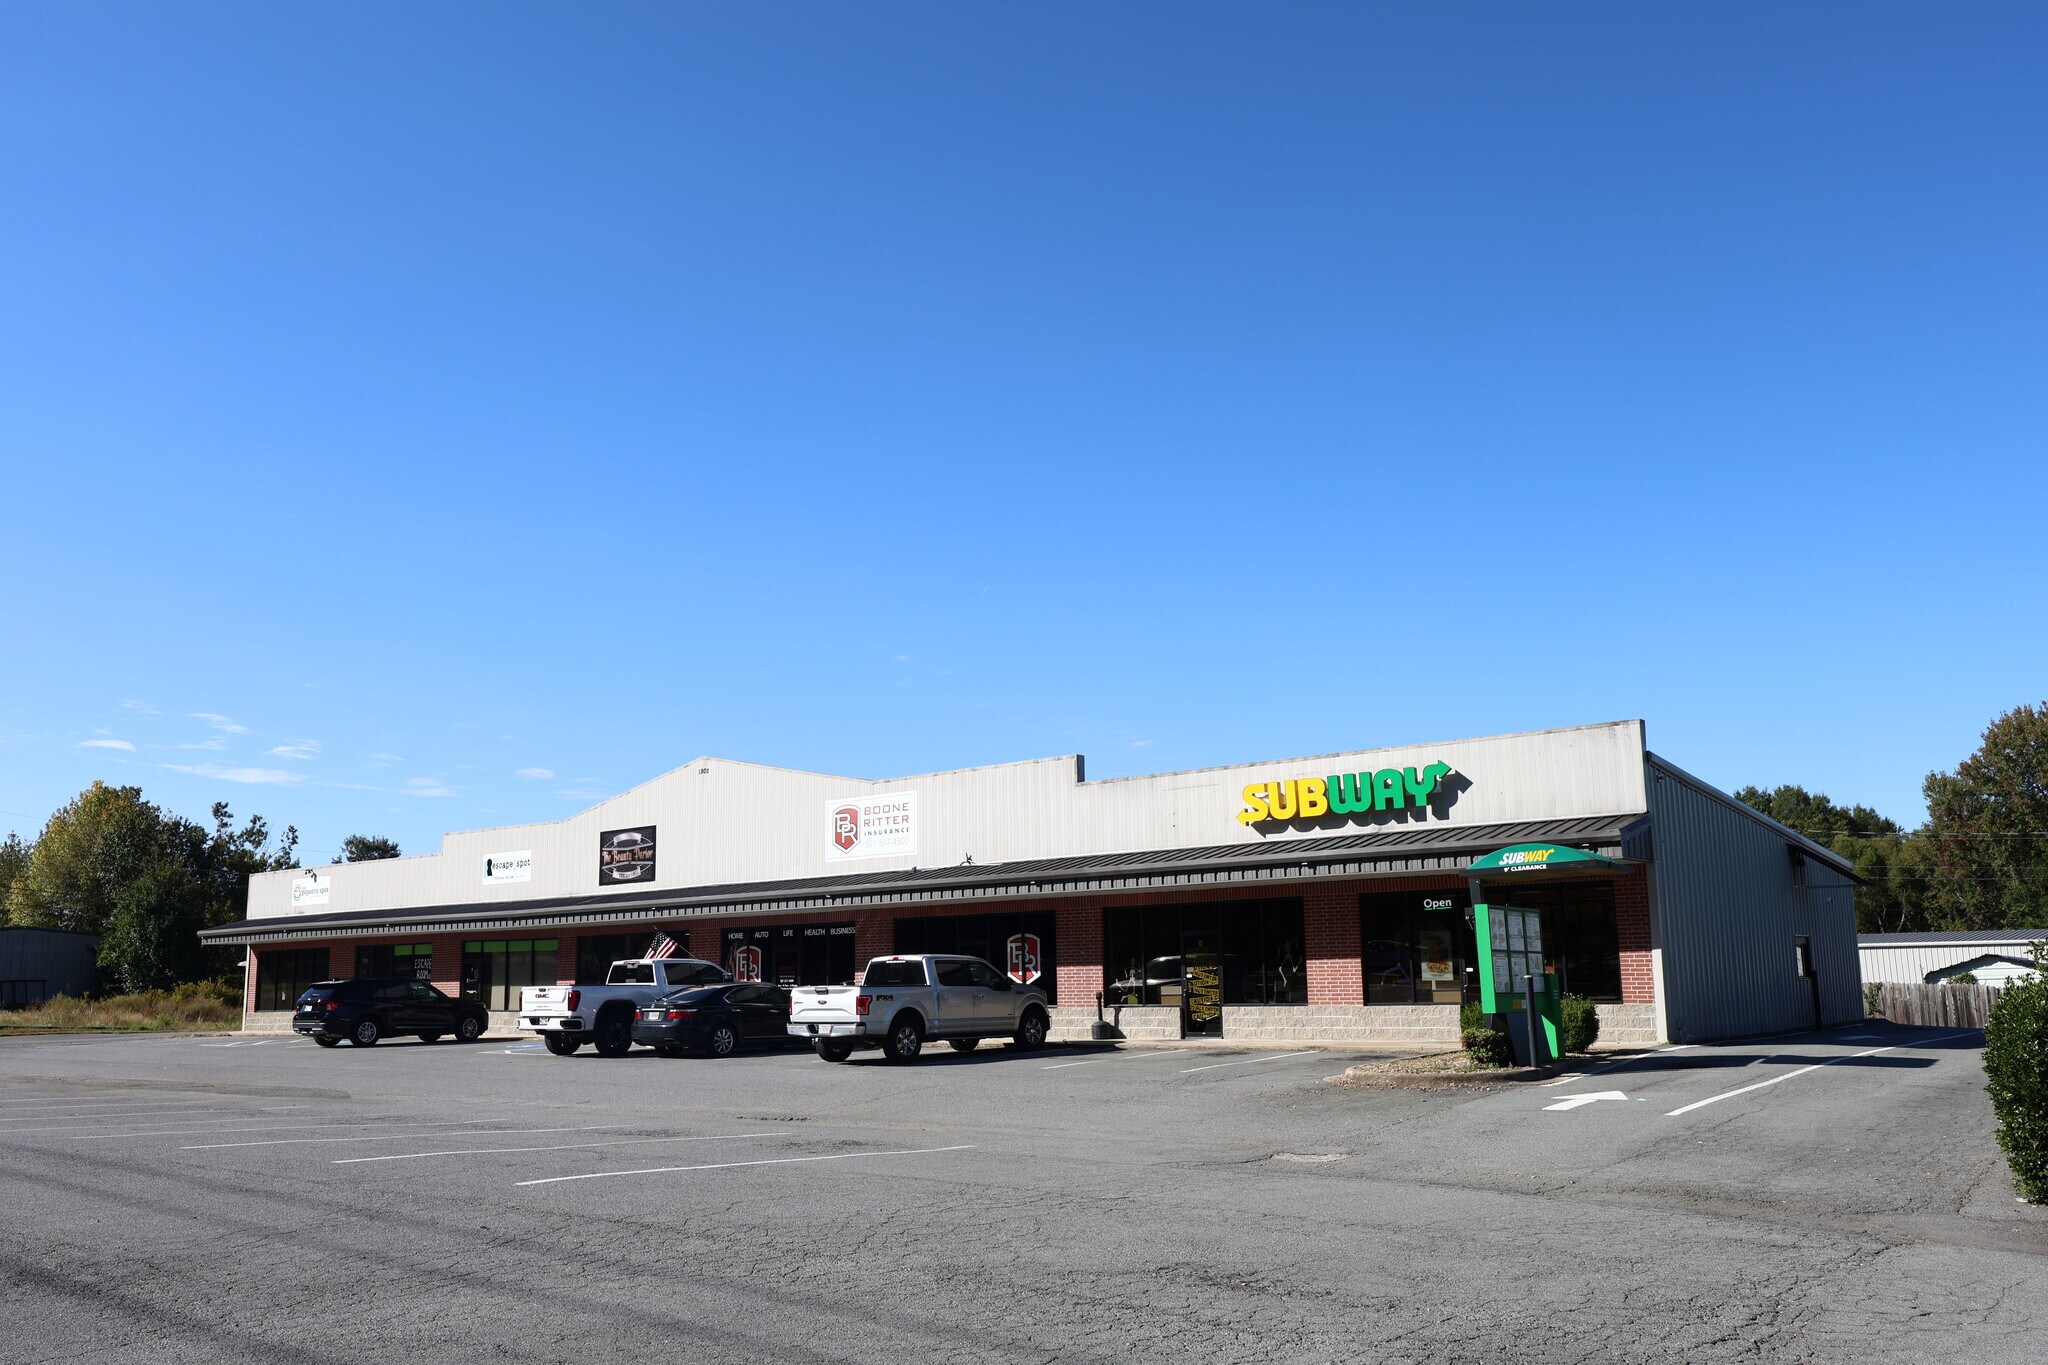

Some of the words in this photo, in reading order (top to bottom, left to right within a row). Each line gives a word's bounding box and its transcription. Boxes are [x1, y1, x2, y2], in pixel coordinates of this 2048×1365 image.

[1236, 759, 1453, 827] SUBWAY
[864, 803, 909, 815] BOONE
[863, 815, 909, 827] RITTER
[864, 827, 909, 836] INSURANCE
[1498, 848, 1555, 866] SUBWAY
[492, 861, 514, 870] escape
[516, 859, 531, 868] spot
[1510, 863, 1547, 873] CLEARANCE
[301, 888, 319, 896] popcorn
[319, 886, 329, 895] spot
[1423, 898, 1452, 910] Open
[783, 929, 794, 937] LIFE
[804, 928, 826, 936] HEALTH
[830, 927, 855, 935] BUSINESS
[414, 958, 432, 969] ESCAPE
